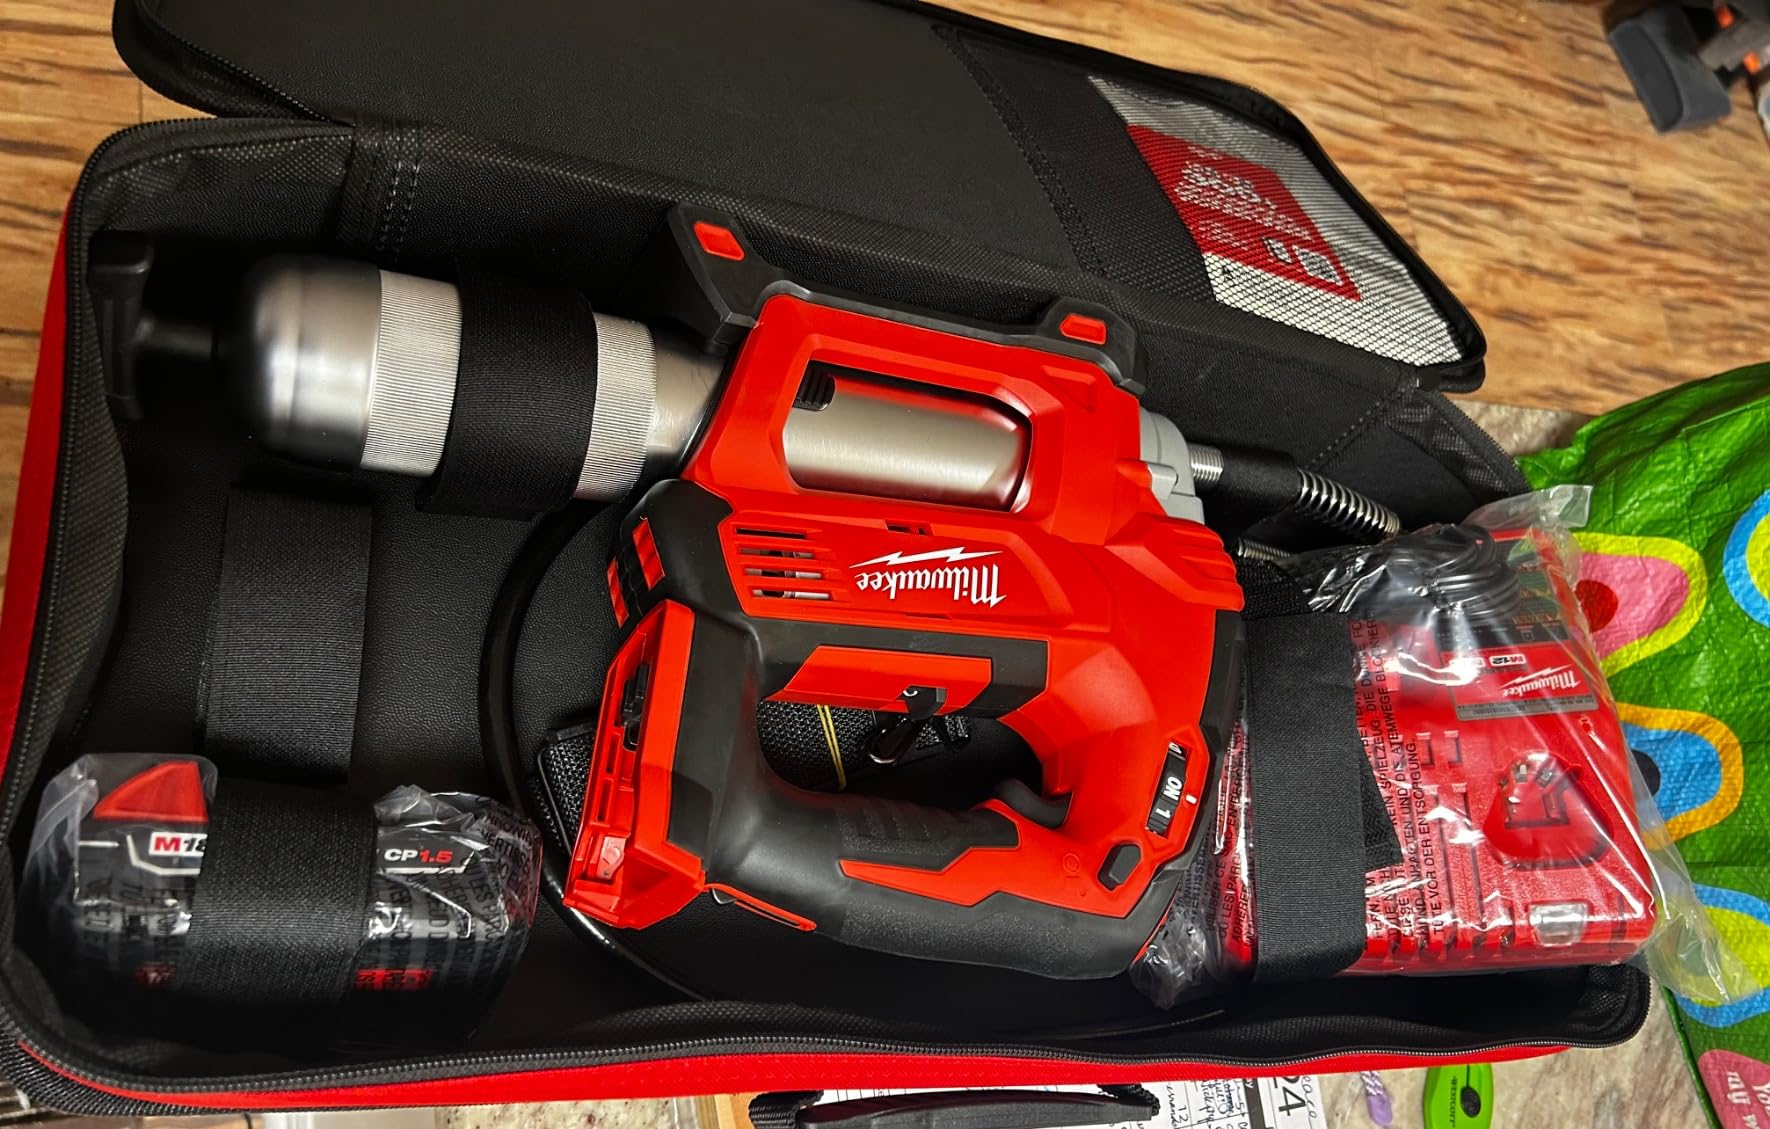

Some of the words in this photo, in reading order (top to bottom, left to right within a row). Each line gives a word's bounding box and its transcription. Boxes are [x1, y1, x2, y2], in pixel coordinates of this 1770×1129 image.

[853, 563, 1007, 608] Milwaukee
[1492, 655, 1523, 665] M12
[1500, 669, 1582, 697] Milwaukee
[1364, 693, 1376, 710] DIE
[1378, 688, 1401, 755] ATEMWEGE
[1163, 776, 1183, 800] ON
[1397, 788, 1410, 814] UND
[384, 848, 454, 865] CP1.5
[1421, 839, 1433, 865] DER
[1426, 871, 1439, 898] VOR
[1222, 894, 1235, 917] LES
[1178, 1105, 1189, 1122] 12
